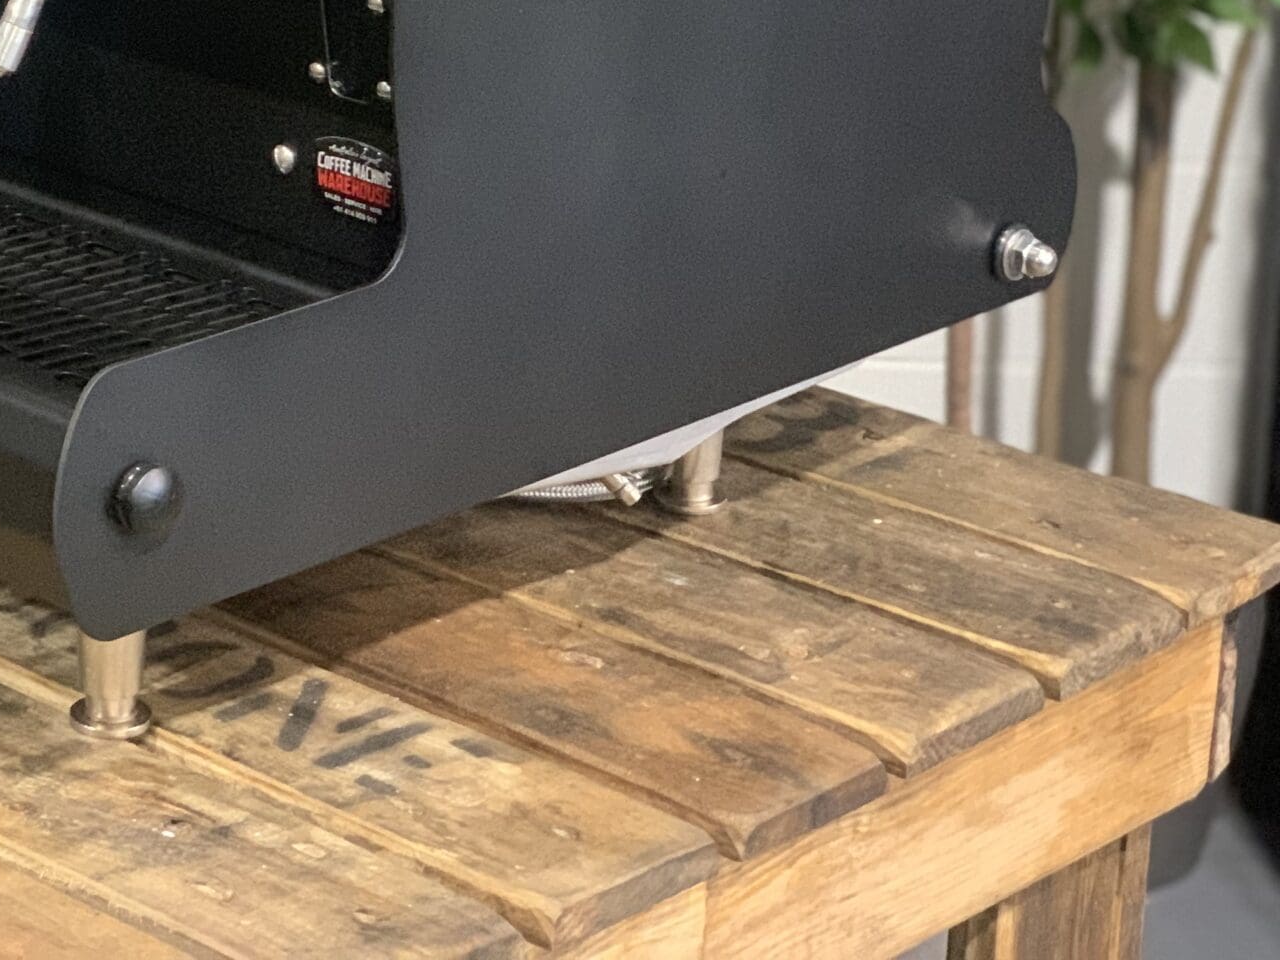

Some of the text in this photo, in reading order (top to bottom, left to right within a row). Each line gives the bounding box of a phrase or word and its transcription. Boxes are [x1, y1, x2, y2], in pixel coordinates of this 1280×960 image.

[317, 151, 351, 176] COFFEE
[352, 161, 393, 189] MACHINE
[317, 167, 392, 208] WAREHOUSE
